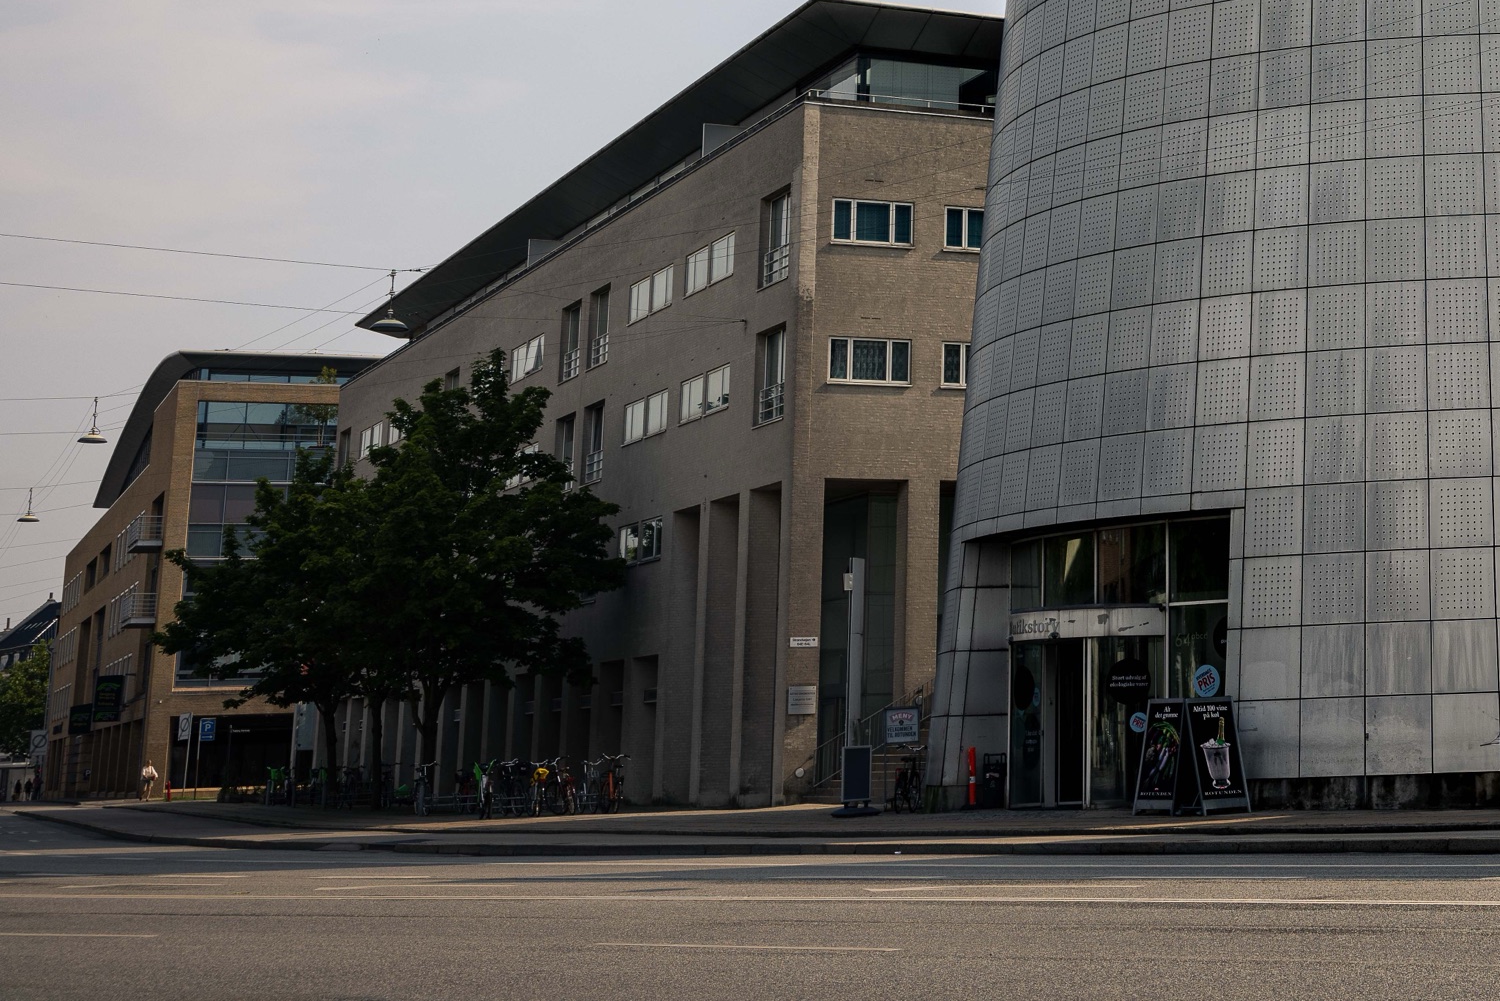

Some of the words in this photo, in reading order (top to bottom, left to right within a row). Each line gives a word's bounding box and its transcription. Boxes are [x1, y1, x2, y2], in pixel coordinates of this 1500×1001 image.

[1197, 672, 1216, 691] PRIS
[1192, 705, 1206, 713] Altid
[891, 713, 913, 721] MENY
